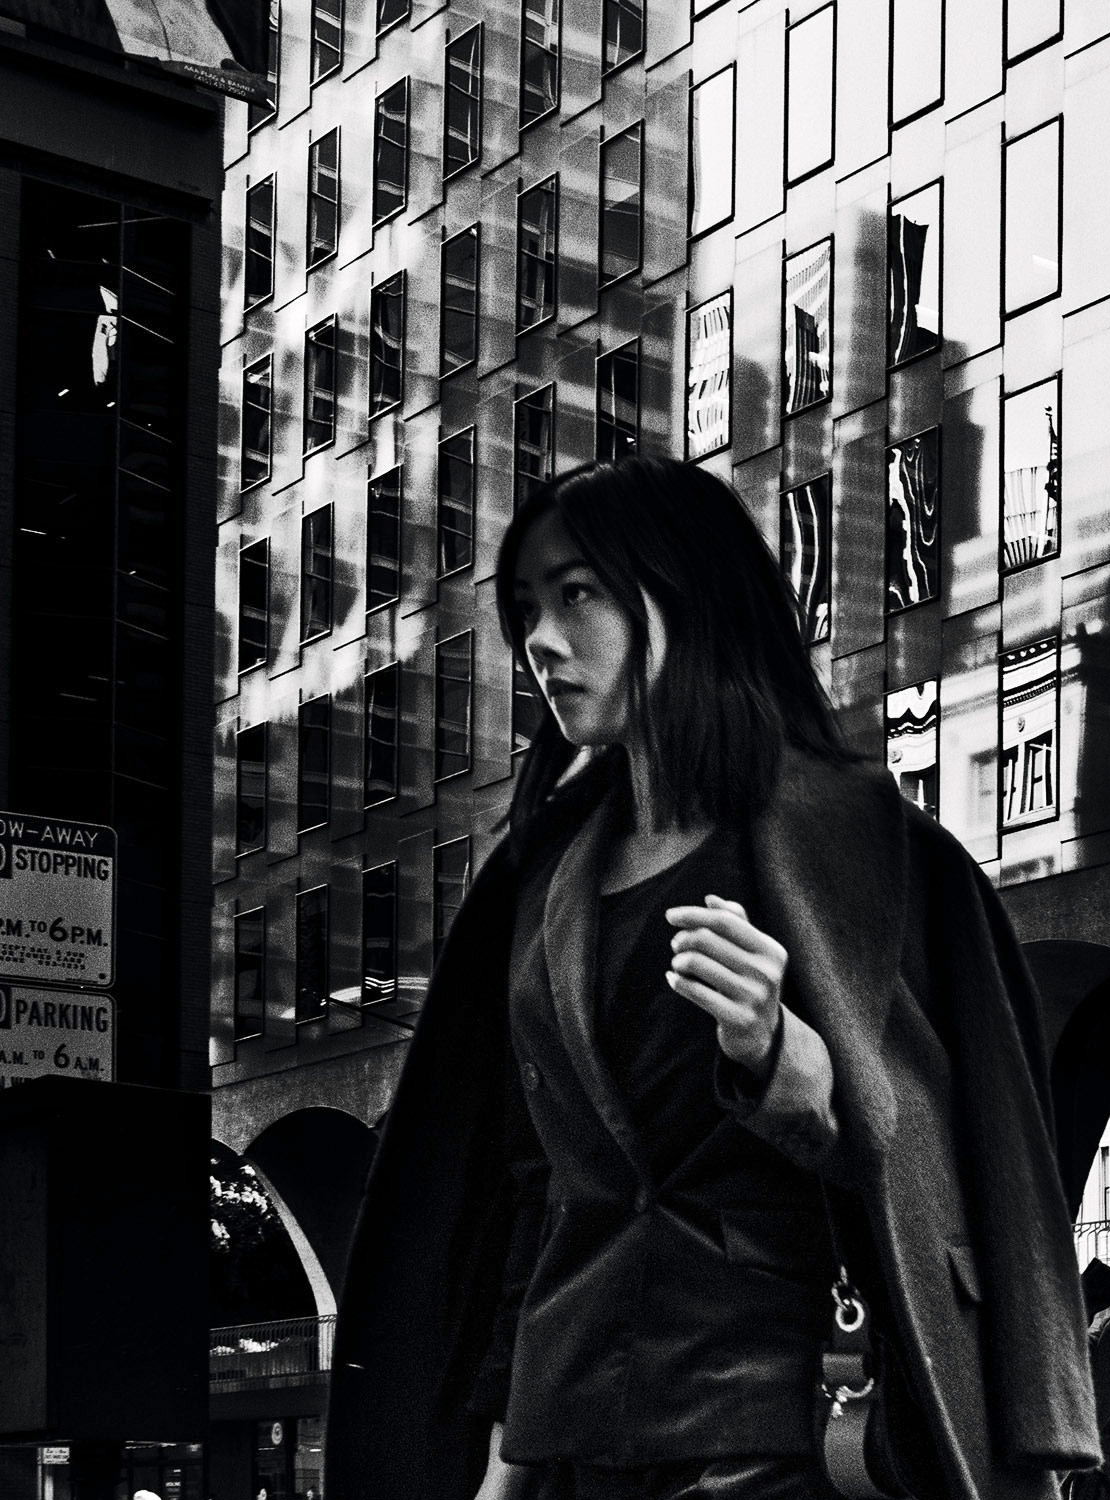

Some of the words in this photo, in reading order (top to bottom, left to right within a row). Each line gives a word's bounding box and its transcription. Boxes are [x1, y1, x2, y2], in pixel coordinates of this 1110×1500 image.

[200, 70, 218, 82] FLAG
[227, 79, 256, 93] BANNER
[15, 848, 109, 881] STOPPING
[28, 920, 47, 933] TO
[49, 917, 68, 942] 6
[71, 926, 109, 947] P.M.
[20, 951, 52, 960] TOWED
[57, 955, 82, 964] CARS
[15, 999, 108, 1033] PARKING
[32, 1050, 45, 1060] TO
[54, 1043, 70, 1069] 6
[74, 1056, 105, 1072] A.M.
